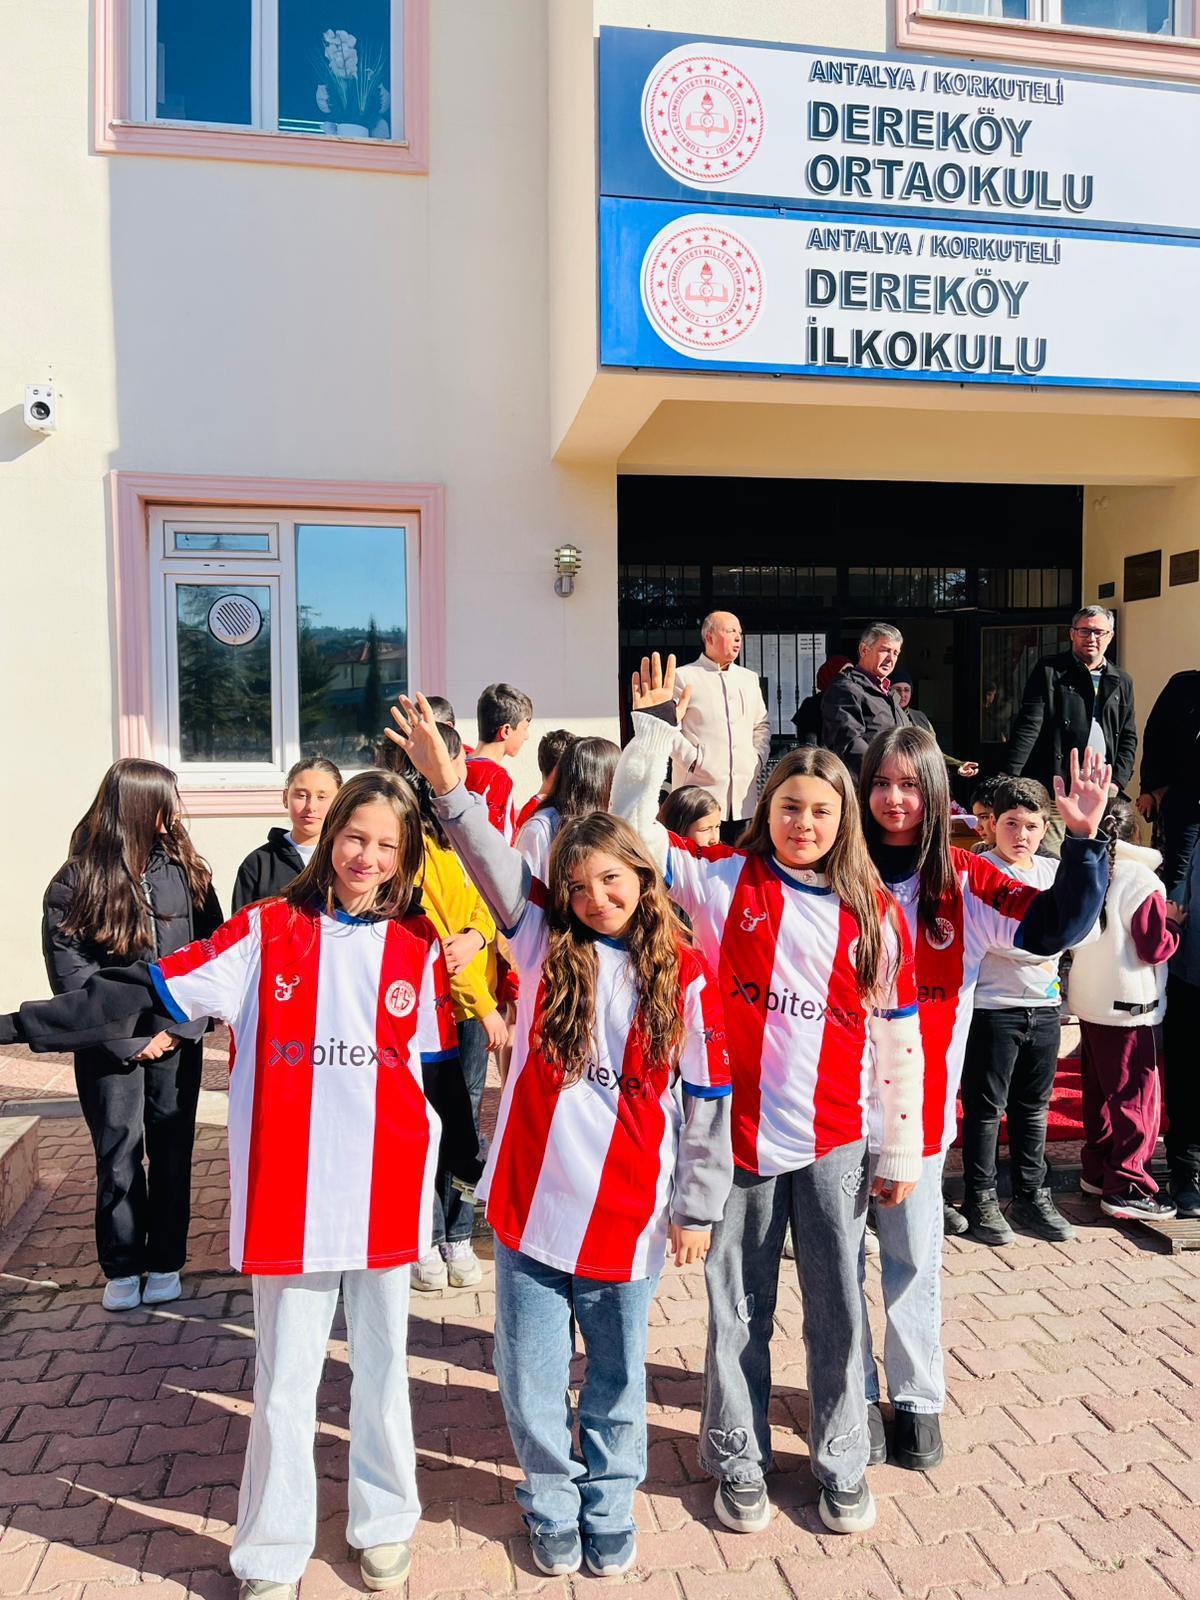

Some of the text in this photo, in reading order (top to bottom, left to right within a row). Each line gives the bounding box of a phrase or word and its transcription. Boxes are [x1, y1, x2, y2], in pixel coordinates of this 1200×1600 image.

[808, 60, 1065, 105] ANTALYA / KORKUTELİ
[807, 99, 1032, 157] DEREKÖY
[805, 153, 1094, 213] ORTAOKULU
[807, 227, 1061, 265] ANTALYA / KORKUTELİ
[806, 267, 1029, 318] DEREKÖY
[805, 315, 1047, 377] İLKOKULU
